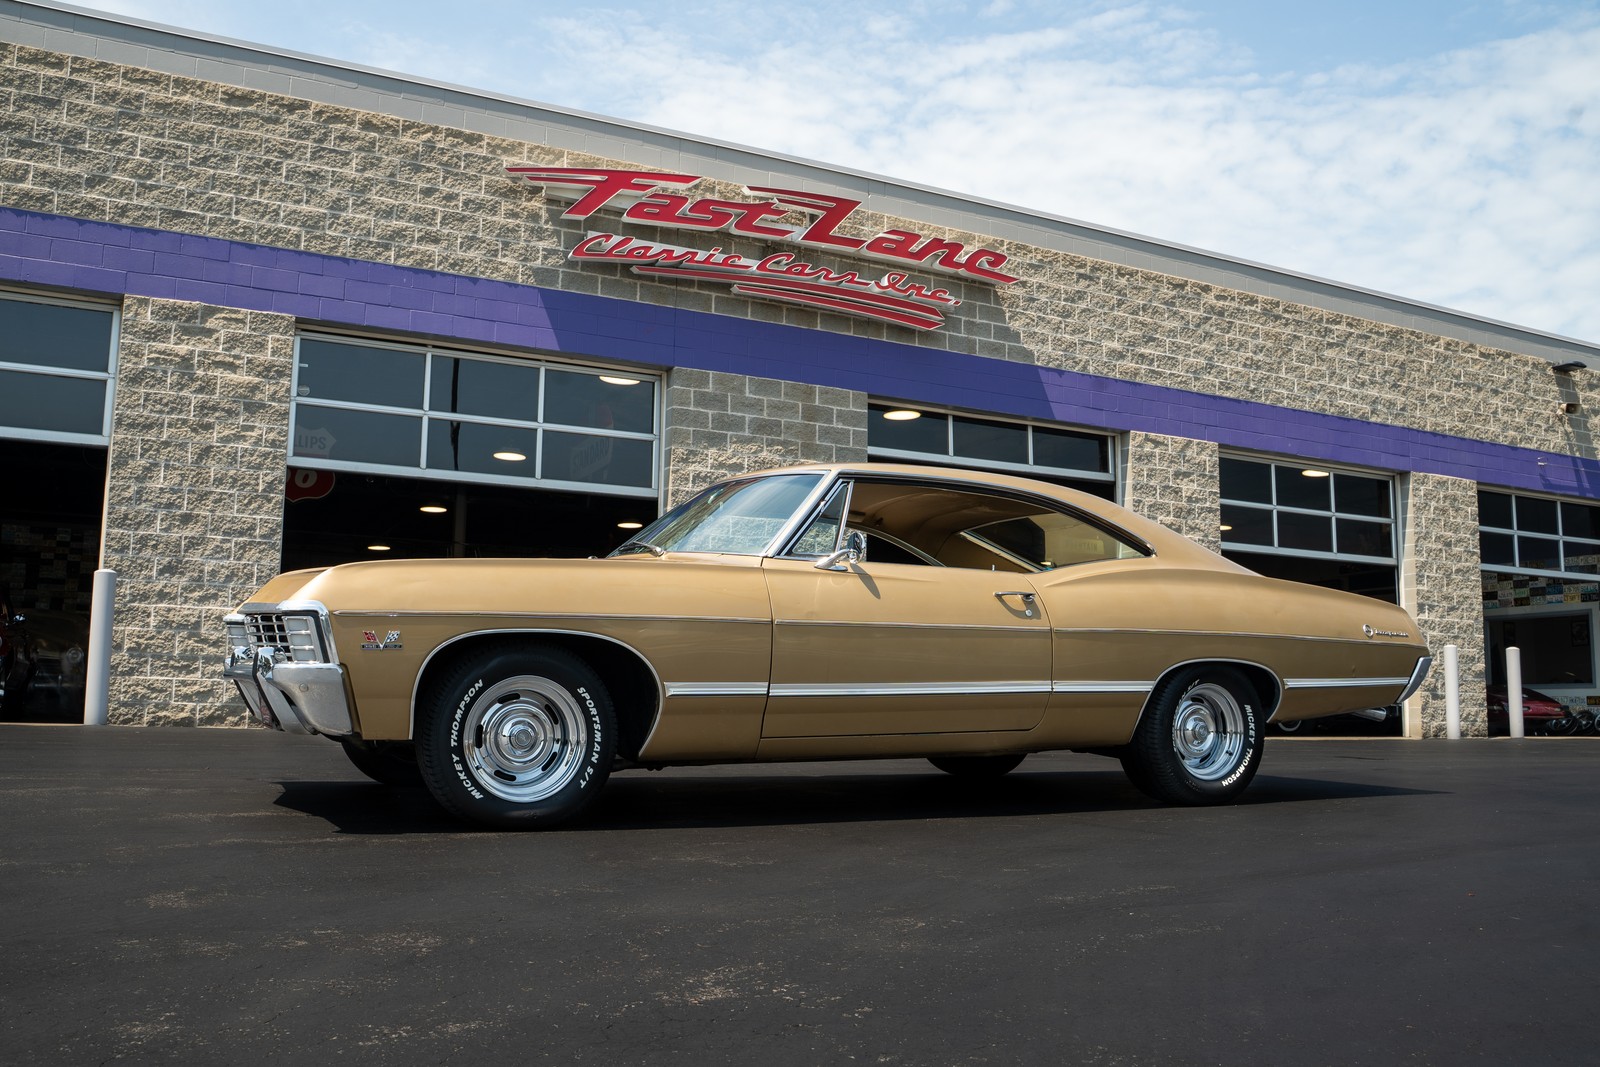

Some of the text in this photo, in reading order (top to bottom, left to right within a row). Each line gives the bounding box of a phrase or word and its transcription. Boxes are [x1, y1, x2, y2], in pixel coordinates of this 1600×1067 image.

[504, 166, 1020, 285] Fast Lane
[570, 233, 963, 307] Classic Cars Inc.
[294, 434, 326, 450] LIPS
[451, 679, 484, 800] MICKEY THOMPSON
[577, 686, 601, 789] SPORTSMAN S/T
[1221, 704, 1256, 787] MICKEY THOMPSON
